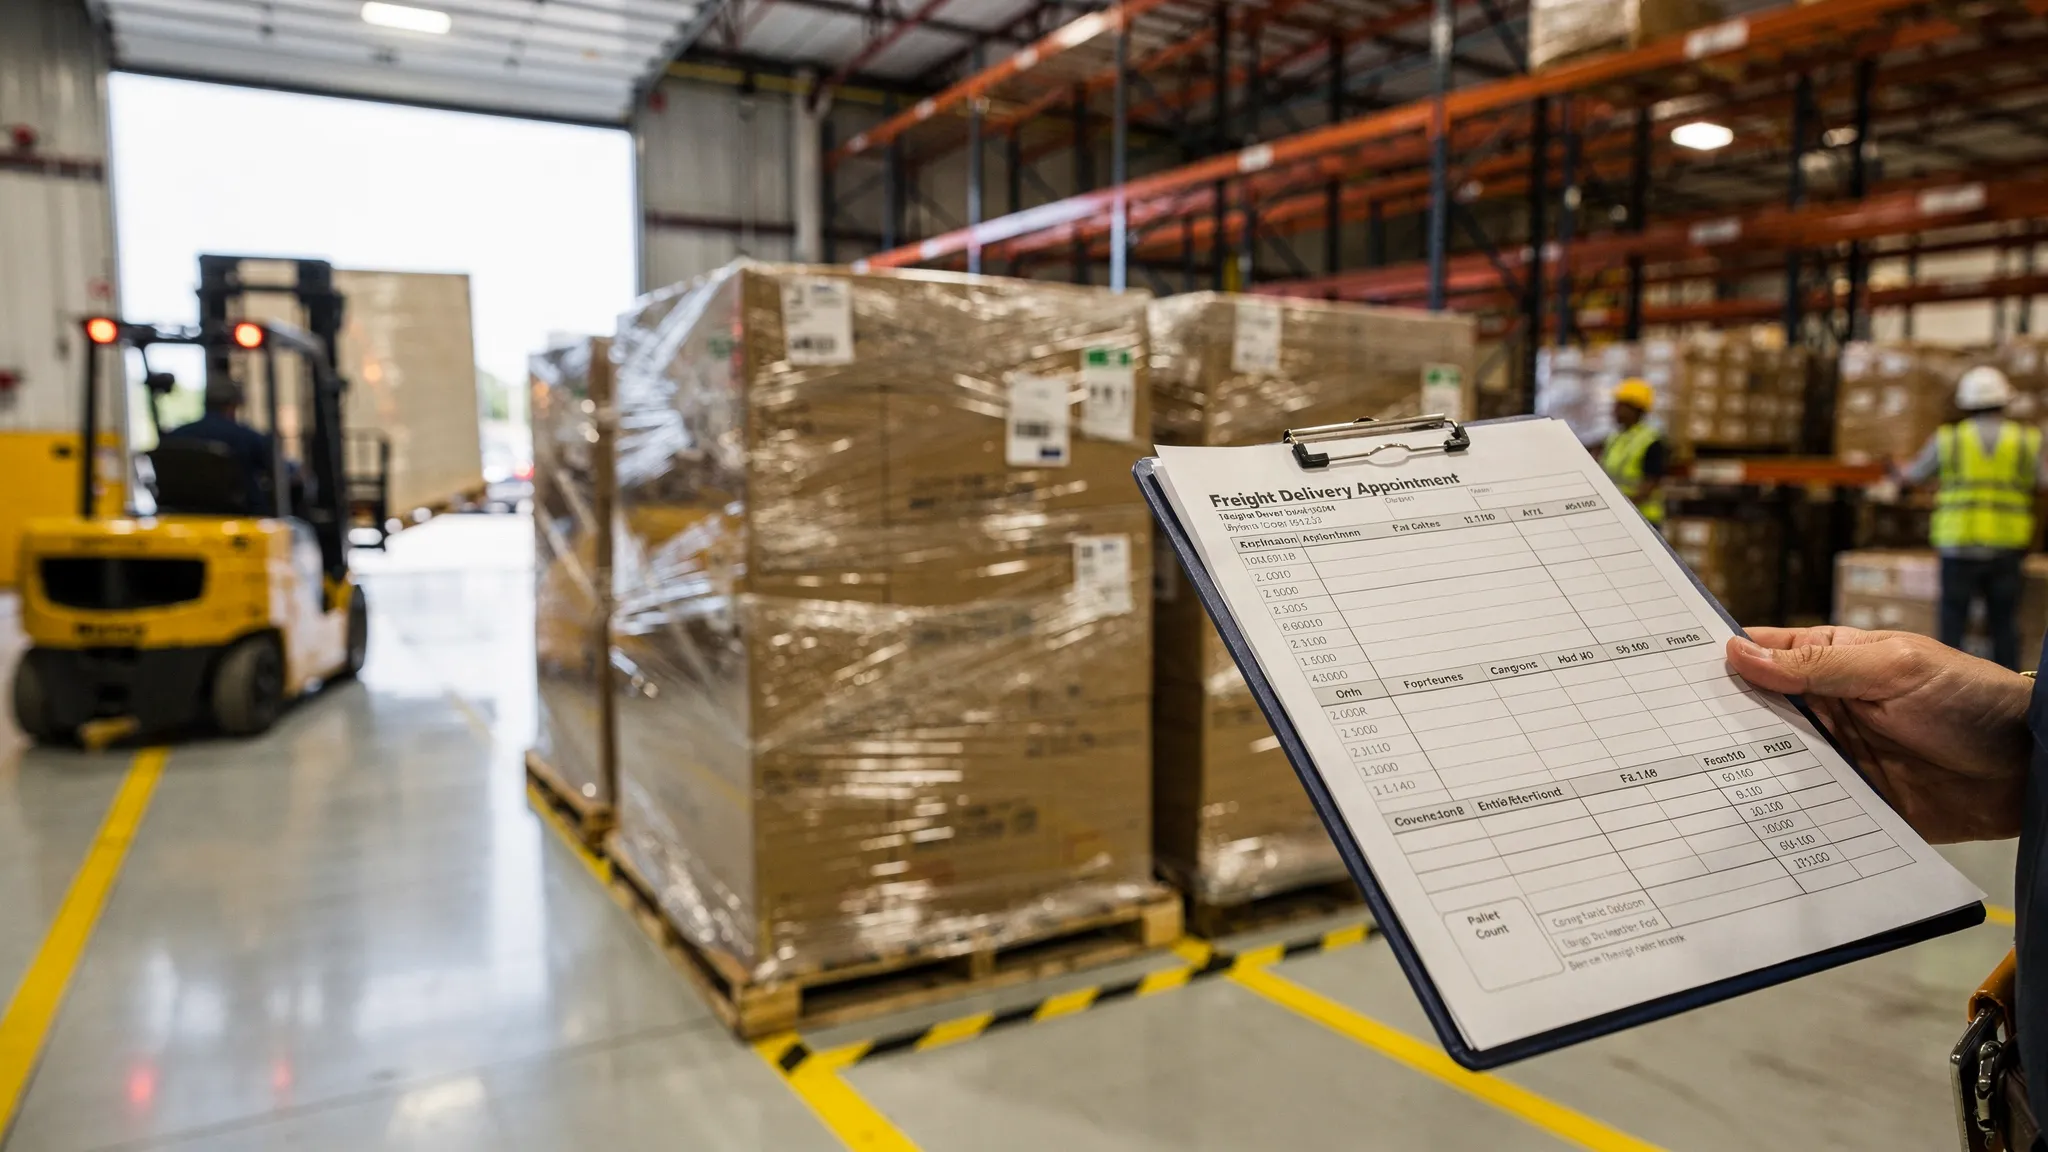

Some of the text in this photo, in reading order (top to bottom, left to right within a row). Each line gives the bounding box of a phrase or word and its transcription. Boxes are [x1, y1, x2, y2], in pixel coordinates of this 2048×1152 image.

[1209, 492, 1278, 508] Freight
[1278, 486, 1352, 501] Delivery
[1356, 473, 1461, 497] Appointment
[1467, 911, 1501, 925] Pallet
[1475, 924, 1511, 940] Count
